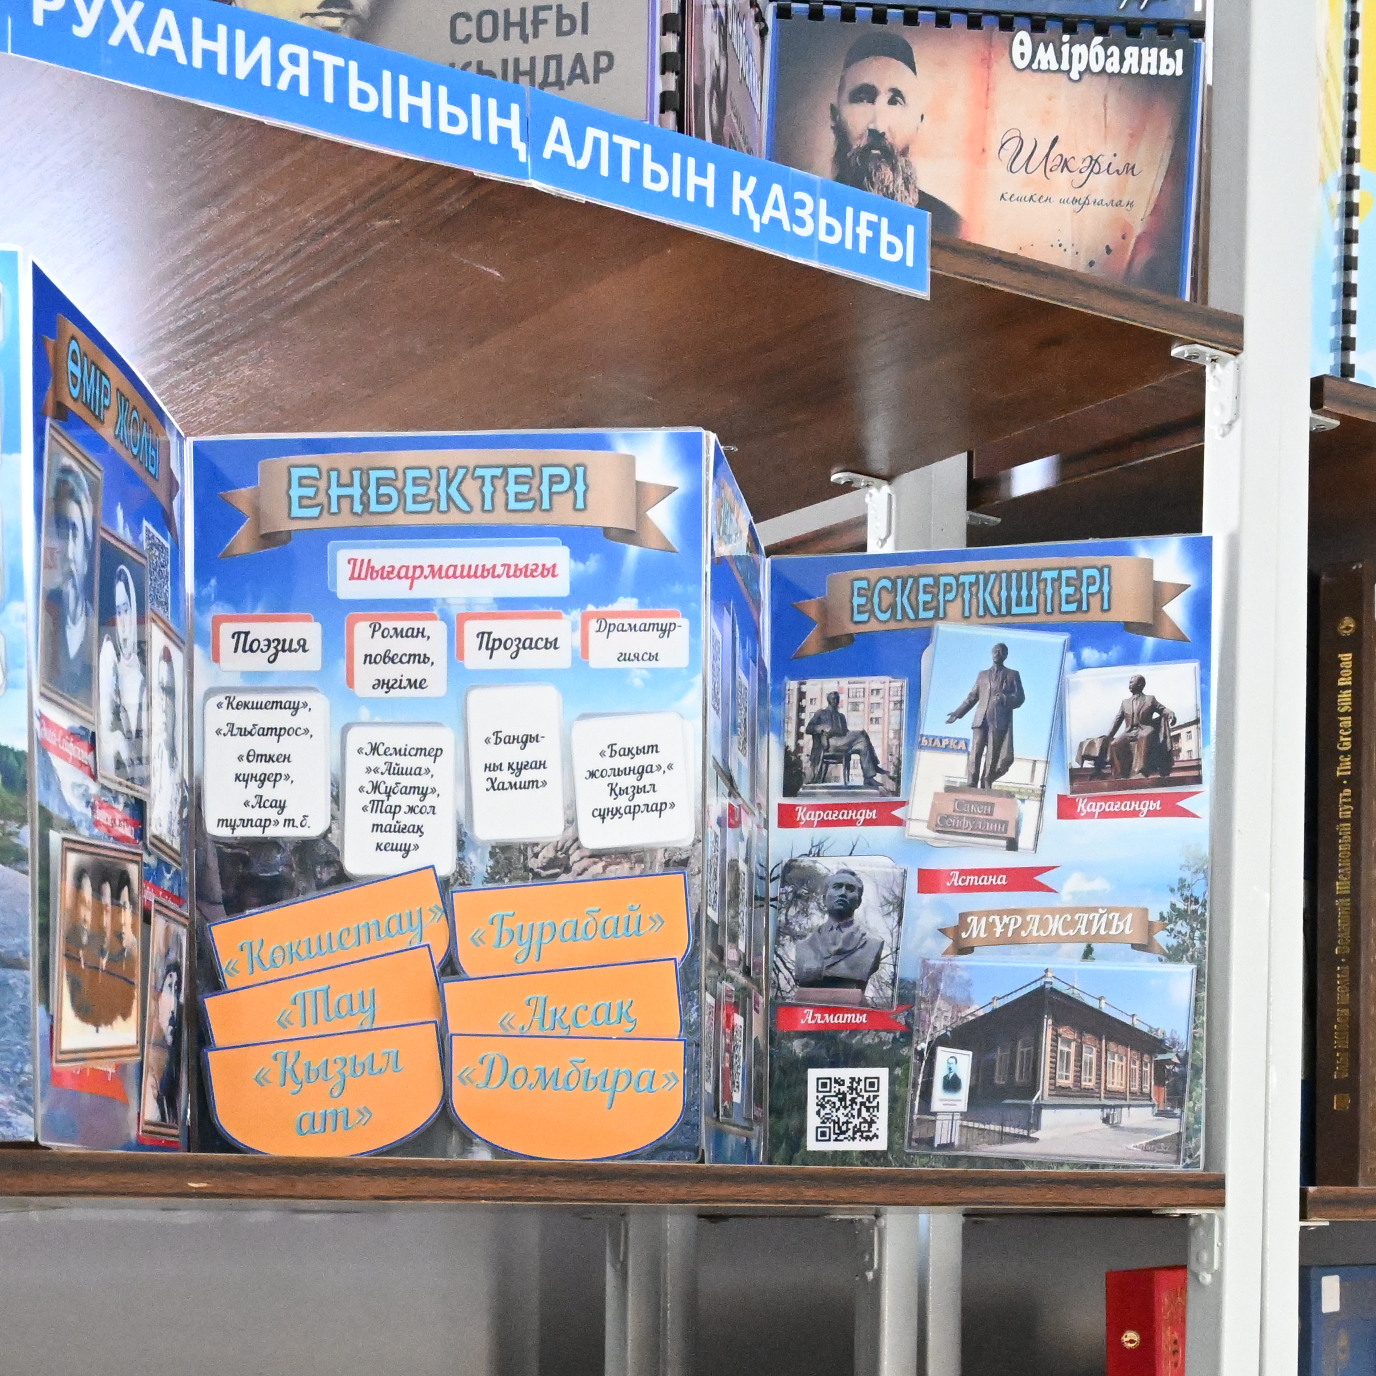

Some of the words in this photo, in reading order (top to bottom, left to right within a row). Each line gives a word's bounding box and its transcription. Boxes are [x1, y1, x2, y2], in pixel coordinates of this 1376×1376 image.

[449, 1, 590, 45] СОҢҒЫ
[1010, 30, 1185, 81] Өмірбаяны
[540, 115, 716, 209] АЛТЫН
[731, 172, 916, 269] ҚАЗЫҒЫ
[67, 335, 112, 423] ӨМІР
[287, 463, 589, 520] ЕҢБЕКТЕРІ
[346, 555, 559, 591] Шығармашылығы
[850, 565, 1112, 624] ЕСКЕРТКІШТЕРІ
[369, 622, 431, 643] Роман,
[594, 618, 683, 642] Драматур-
[231, 629, 309, 663] Поэзия
[477, 631, 560, 656] Прозасы
[363, 649, 436, 669] повесть,
[617, 649, 660, 665] гиясы
[1335, 652, 1353, 686] Road
[372, 674, 427, 694] әңгіме
[1335, 689, 1353, 713] Silk
[215, 722, 314, 741] «Альбатрос»,
[484, 730, 546, 750] «Банды-
[1335, 716, 1353, 751] Great
[237, 749, 292, 766] «Өткен
[357, 742, 443, 763] «Жемістер
[599, 741, 660, 759] «Бақыт
[484, 761, 503, 773] ны
[507, 759, 547, 776] қуған
[1335, 754, 1353, 777] The
[234, 769, 294, 787] күндер»,
[486, 776, 547, 793] Хамит»
[607, 780, 657, 802] Қызыл
[243, 796, 287, 816] «Асау
[361, 801, 402, 819] «Тар
[405, 803, 436, 817] жол
[795, 805, 878, 826] Қарағанды
[1075, 795, 1162, 819] Қарағанды
[283, 815, 311, 830] т.б.
[371, 818, 425, 836] тайғақ
[375, 837, 420, 855] кешу»
[946, 871, 1008, 888] Астана
[469, 907, 666, 964] «Бурабай»
[961, 911, 1134, 940] МҰРАЖАЙЫ
[224, 901, 446, 979] «Көкшетау»
[277, 982, 380, 1029] «Тау
[498, 993, 638, 1036] «Ақсақ
[800, 1009, 869, 1026] Алматы
[253, 1046, 403, 1099] «Қызыл
[457, 1051, 681, 1110] «Домбыра»
[295, 1104, 373, 1137] ат»
